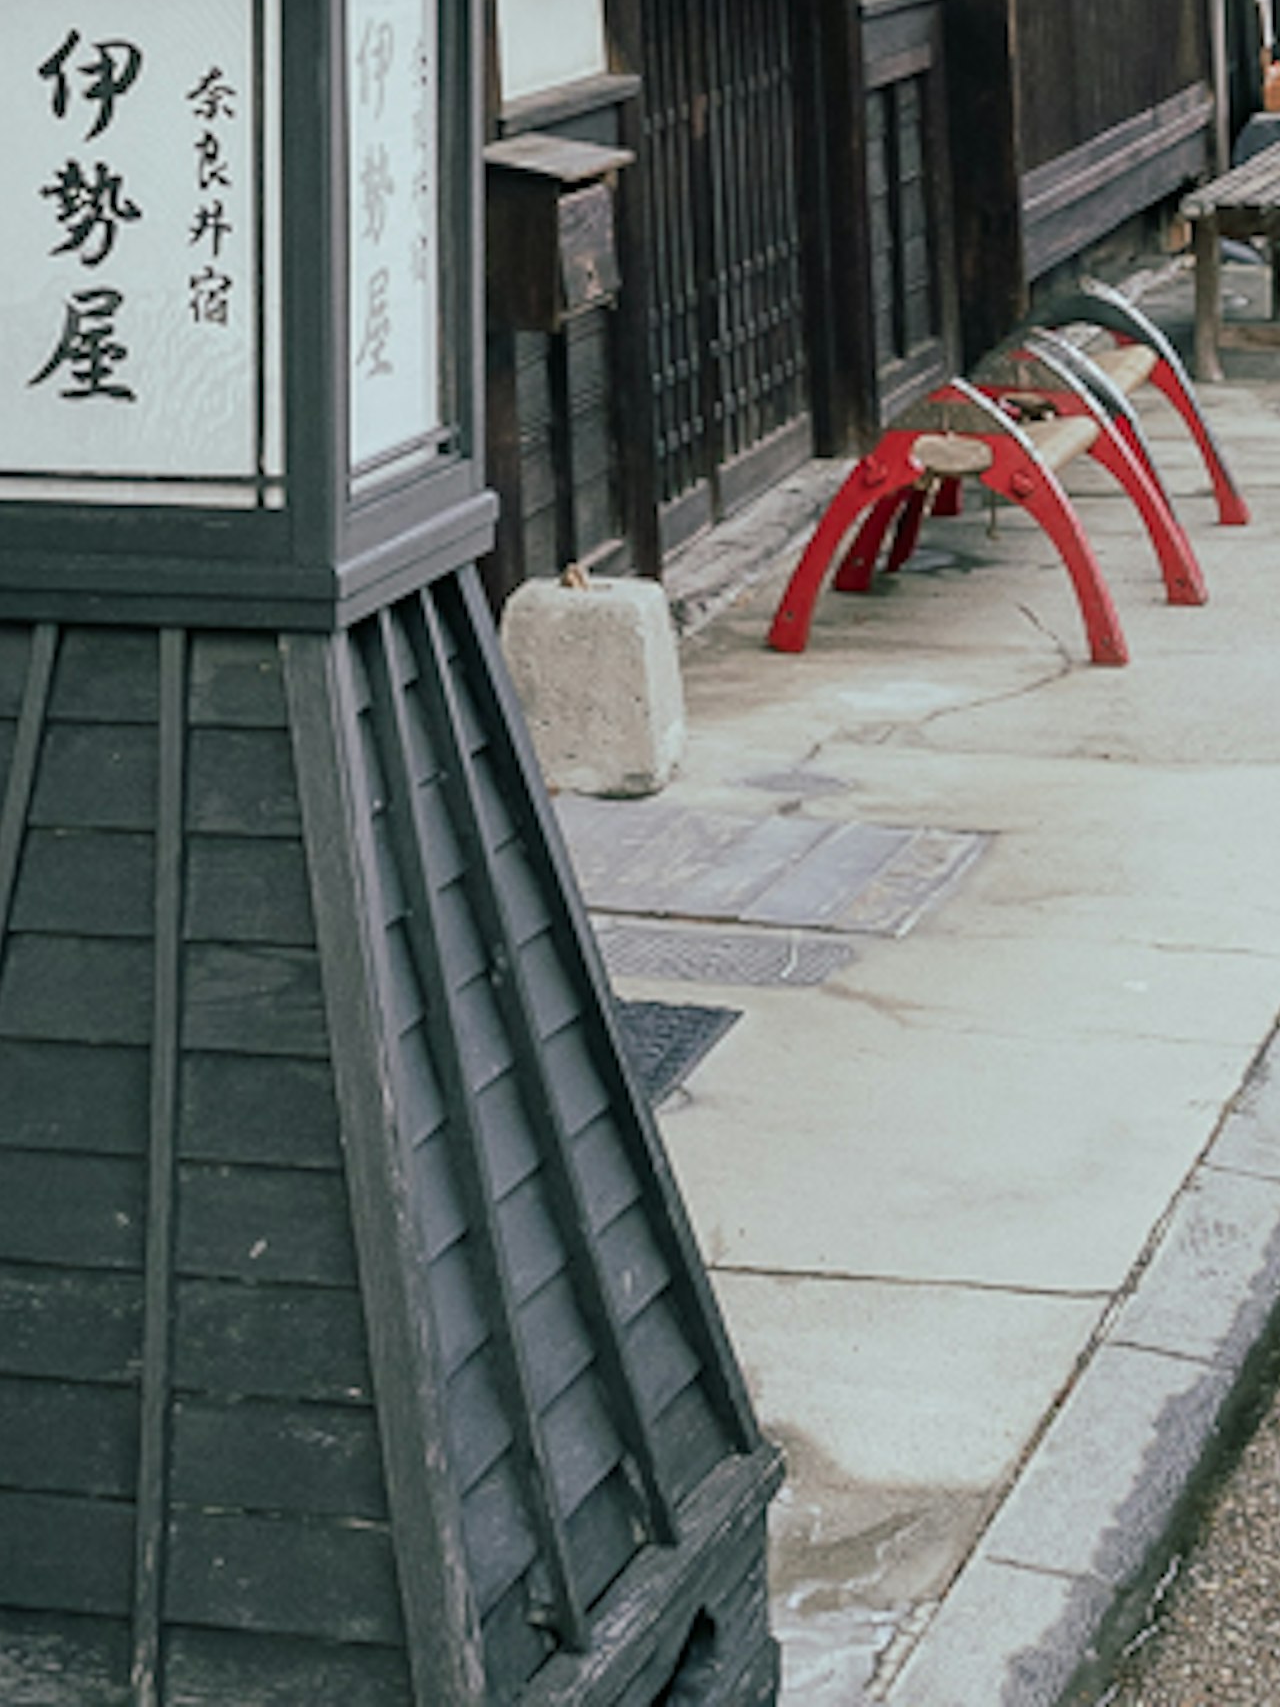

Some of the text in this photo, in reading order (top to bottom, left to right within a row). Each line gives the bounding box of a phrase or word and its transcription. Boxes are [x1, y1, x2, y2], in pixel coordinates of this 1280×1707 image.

[29, 28, 143, 403] 伊勢屋
[185, 66, 240, 327] 奈良井宿
